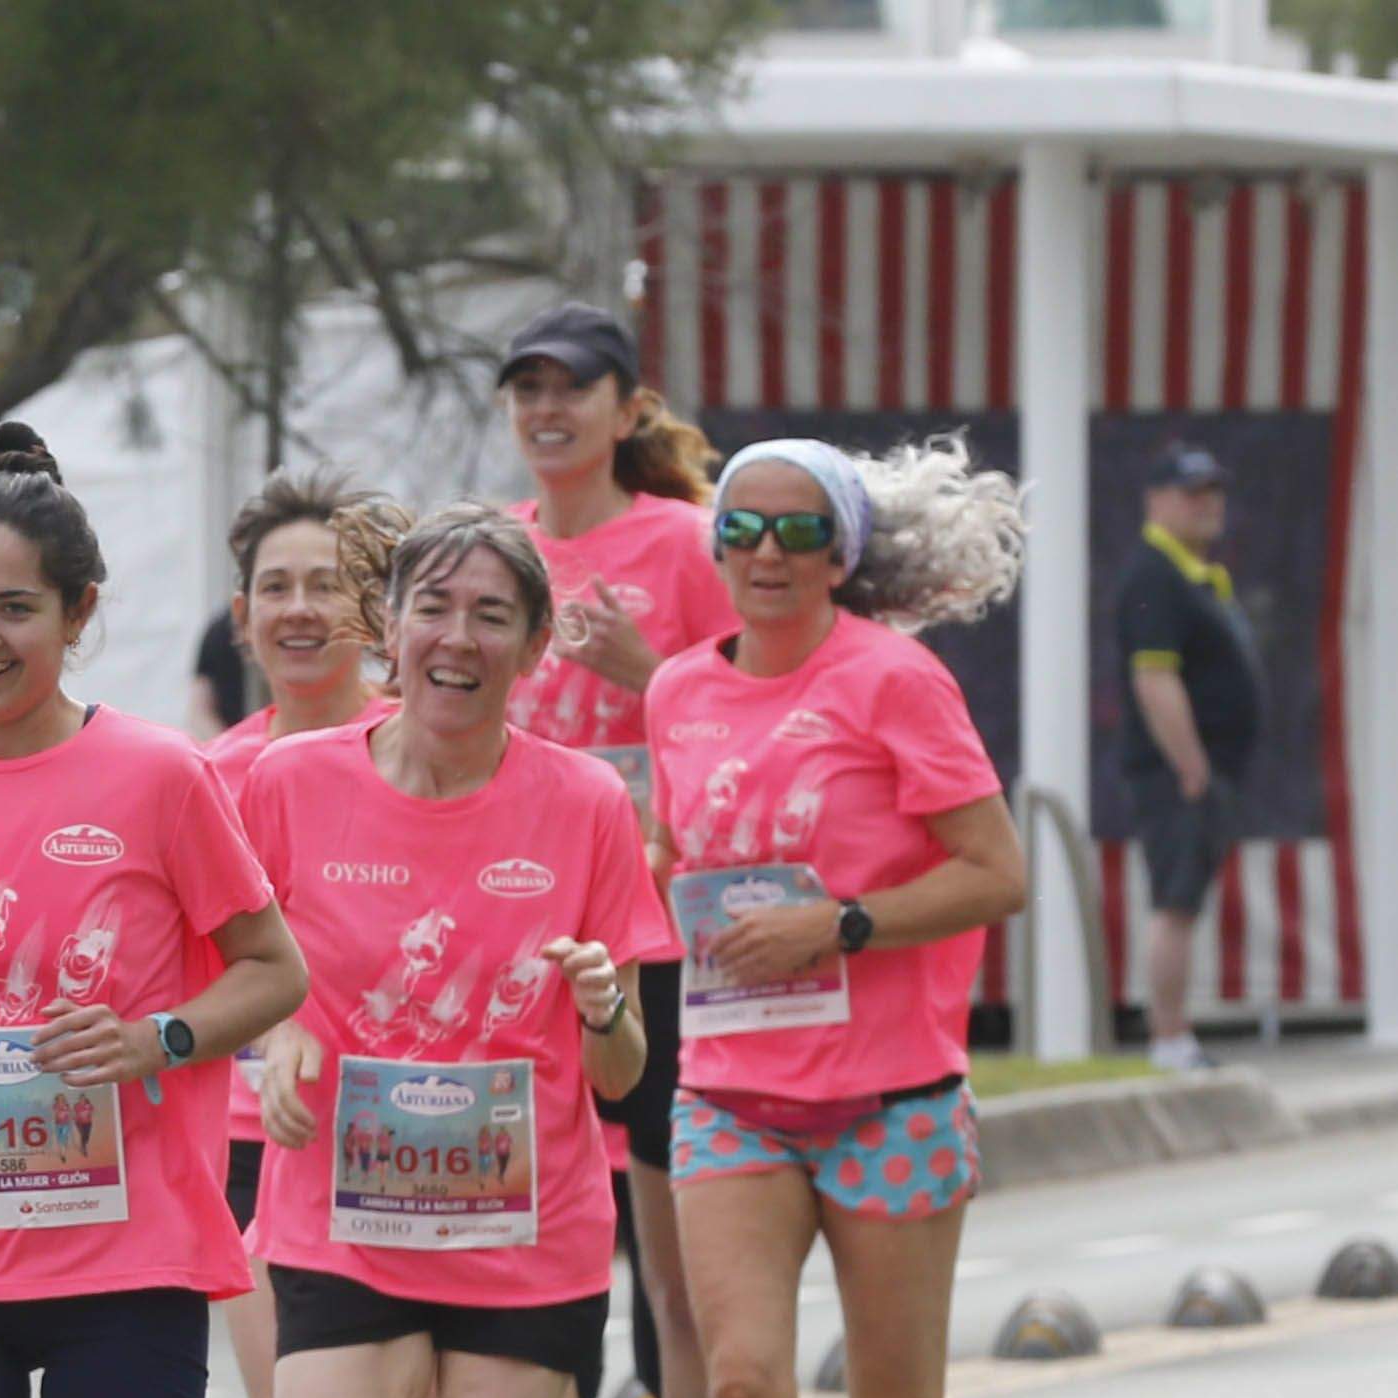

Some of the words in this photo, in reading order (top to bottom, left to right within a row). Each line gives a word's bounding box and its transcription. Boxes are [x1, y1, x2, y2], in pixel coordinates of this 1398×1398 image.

[322, 861, 410, 885] OYSHO
[394, 1144, 472, 1177] 016
[35, 1199, 101, 1214] Santander
